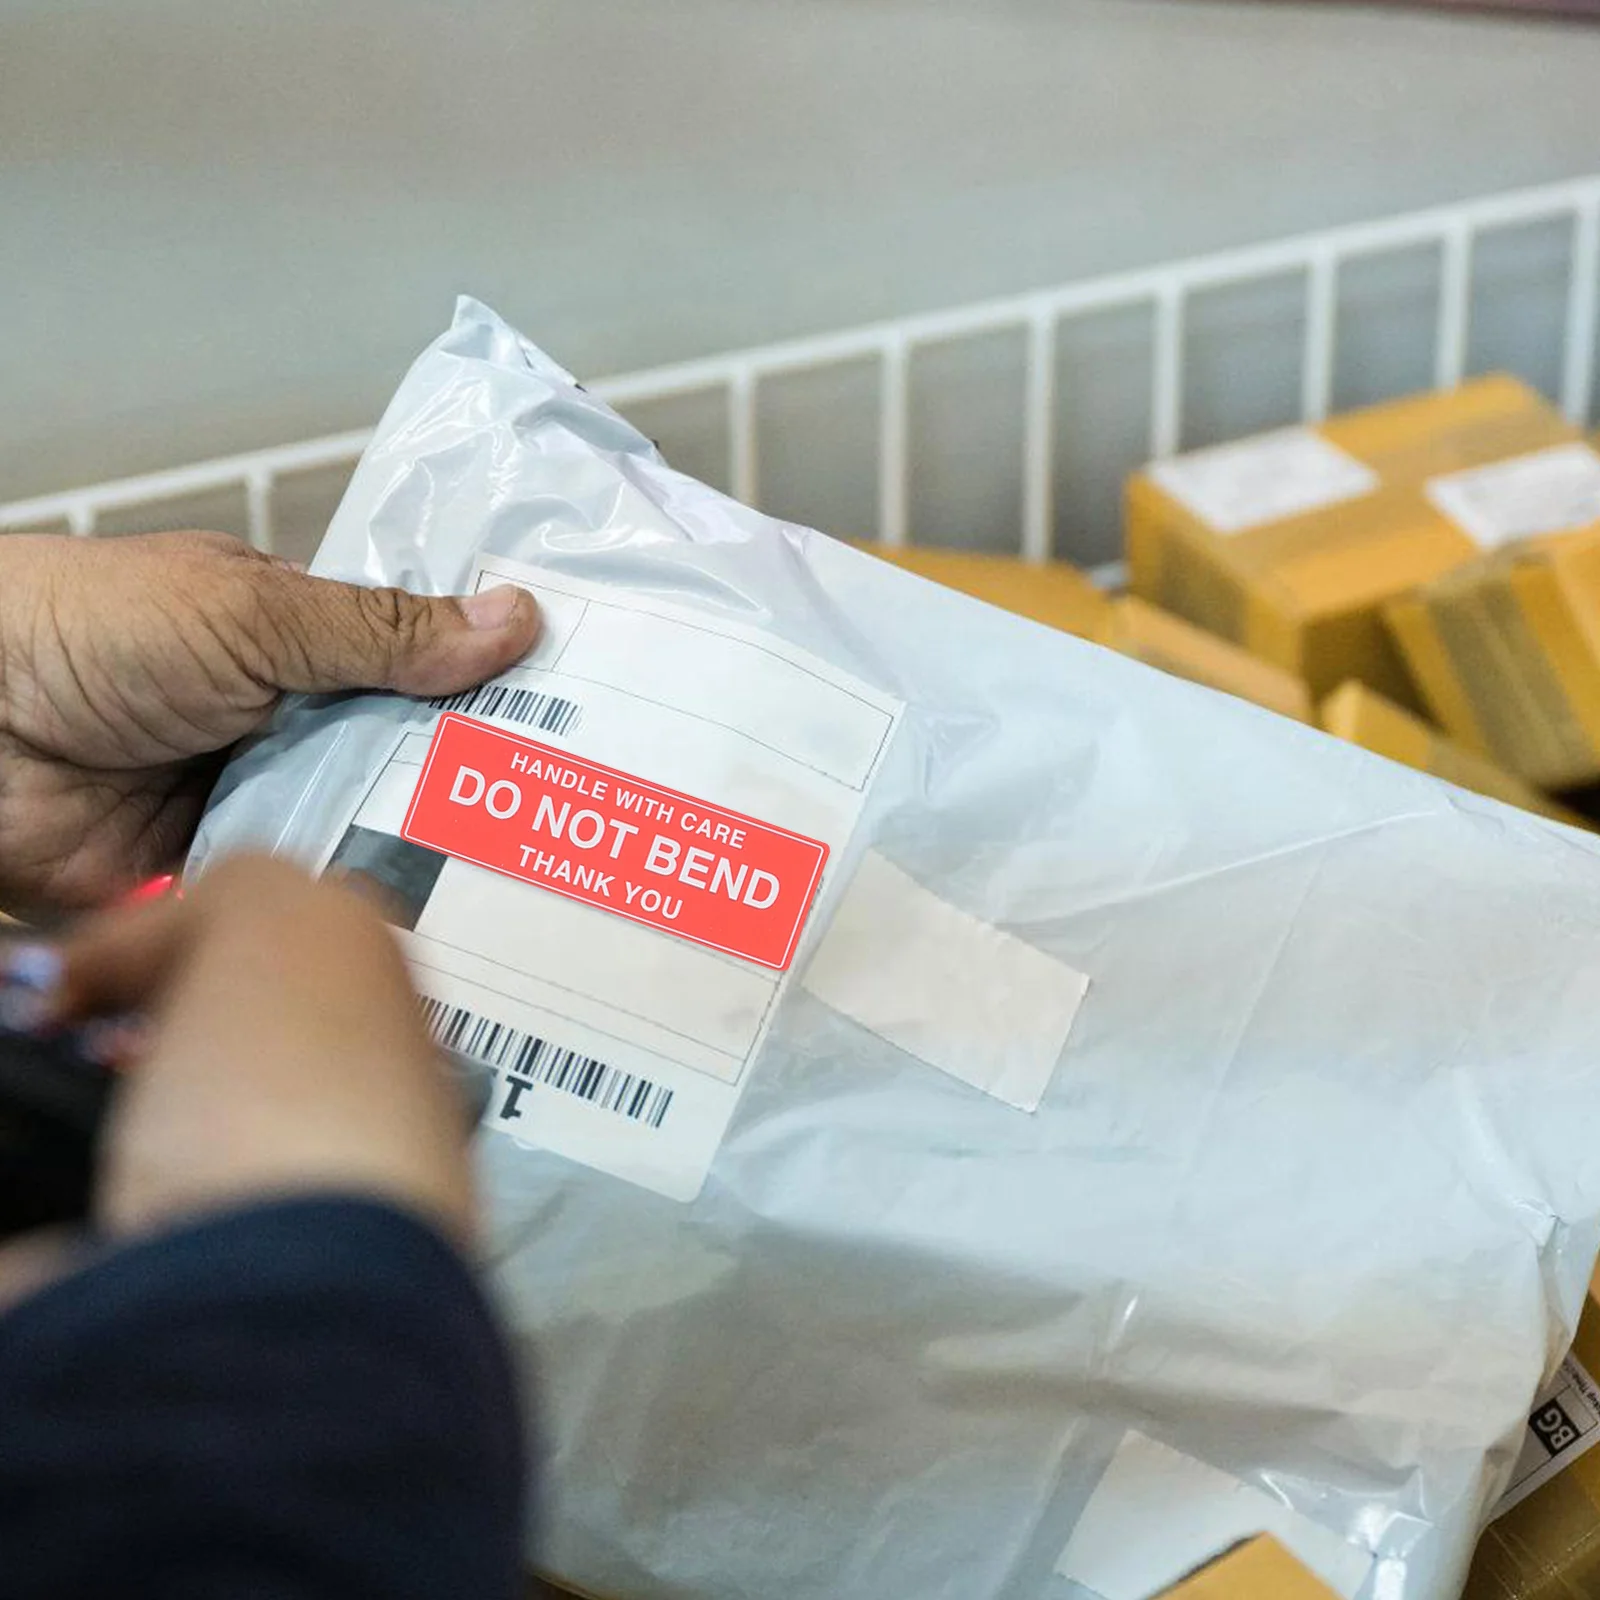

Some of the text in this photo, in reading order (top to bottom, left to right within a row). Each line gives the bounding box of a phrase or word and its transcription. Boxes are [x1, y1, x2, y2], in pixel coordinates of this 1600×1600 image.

[448, 765, 780, 910] DO NOT BEND
[510, 751, 747, 849] HANDLE WITH CARE
[519, 844, 683, 920] THANK YOU
[499, 1075, 534, 1120] 1
[1536, 1407, 1576, 1450] BG
